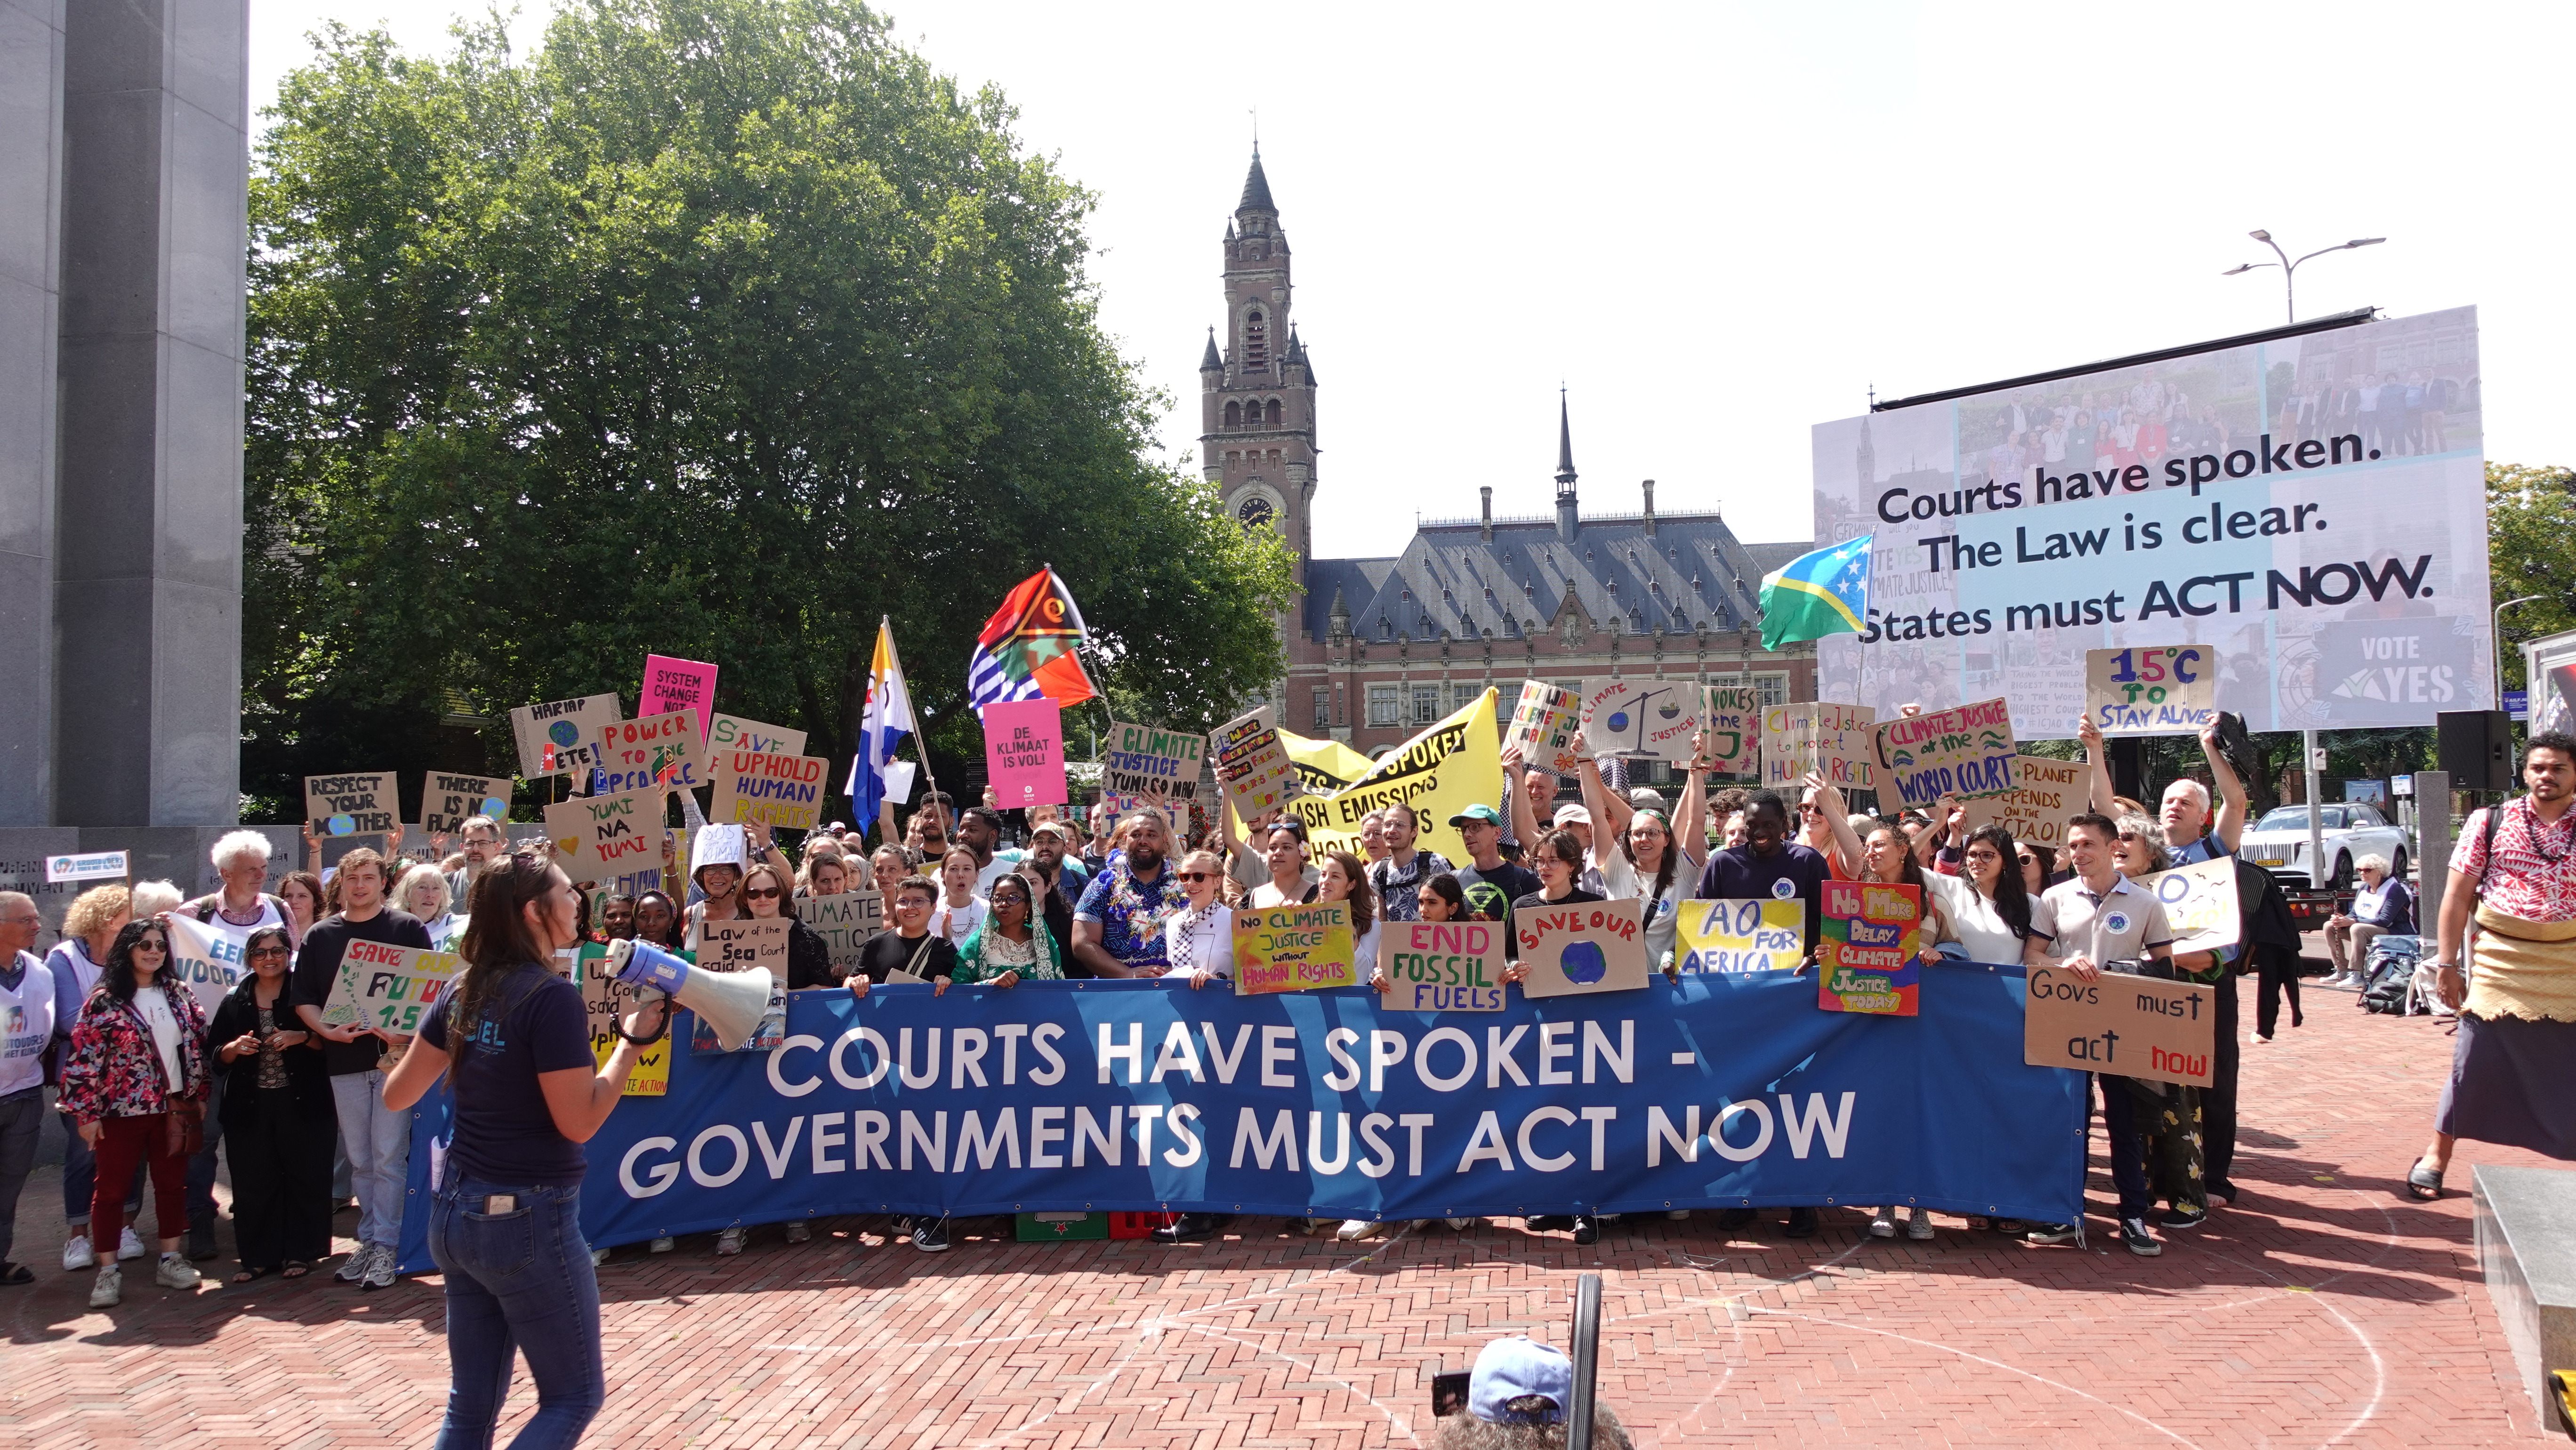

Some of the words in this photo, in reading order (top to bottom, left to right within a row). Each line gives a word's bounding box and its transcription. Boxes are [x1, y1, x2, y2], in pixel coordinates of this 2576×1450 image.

[1877, 479, 2022, 524] Courts
[2036, 468, 2149, 505] have
[2165, 433, 2382, 496] spoken.
[1919, 535, 2002, 573] The
[2017, 526, 2110, 564] Law
[2125, 513, 2162, 551] is
[2182, 501, 2327, 545] clear.
[1858, 606, 1992, 644] States
[2006, 588, 2124, 631] must
[2138, 572, 2254, 620] ACT
[2267, 555, 2433, 611] NOW.
[2361, 636, 2419, 660] VOTE
[657, 670, 701, 688] SYSTEM
[2011, 670, 2037, 678] TAKING
[2382, 666, 2454, 703] YES
[654, 685, 699, 703] CHANGE
[1582, 683, 1627, 724] CLIMATE
[2121, 683, 2166, 704] TO
[663, 701, 687, 713] NOT
[2010, 703, 2049, 715] HIGHEST
[2098, 704, 2152, 729] STAY
[1650, 715, 1696, 742] JUSTICE!
[1710, 713, 1740, 729] the
[1768, 708, 1831, 733] Climate
[1890, 712, 1955, 745] CLIMATE
[604, 716, 687, 749] POWER
[1014, 727, 1030, 739] DE
[1229, 721, 1259, 742] WHERE
[997, 739, 1049, 755] KLIMAAT
[1124, 728, 1199, 760] CLIMATE
[1777, 739, 1791, 752] to
[1798, 733, 1844, 756] protect
[1921, 738, 1937, 754] at
[1940, 733, 1972, 752] the
[621, 749, 645, 764] TO
[1003, 756, 1014, 768] IS
[1018, 753, 1045, 767] VOL!
[1111, 752, 1179, 776] JUSTICE
[598, 770, 605, 785] P
[734, 753, 820, 782] UPHOLD
[1832, 757, 1874, 786] RIGHTS
[1895, 767, 1953, 803] WORLD
[1957, 753, 2017, 793] COURT
[2024, 763, 2078, 784] PLANET
[311, 776, 382, 796] RESPECT
[437, 776, 489, 795] THERE
[737, 776, 816, 803] HUMAN
[1111, 771, 1146, 793] YUMI
[1171, 781, 1196, 799] NAU
[1234, 774, 1266, 796] COURTS
[1267, 764, 1290, 780] MUST
[325, 793, 379, 813] YOUR
[444, 796, 463, 815] IS
[586, 798, 634, 821] YUMI
[1253, 789, 1280, 810] NOT
[2004, 807, 2020, 817] ON
[2023, 808, 2039, 818] THE
[597, 819, 631, 840] NA
[706, 826, 734, 840] SOS
[596, 836, 647, 862] YUMI
[1241, 917, 1261, 928] NO
[1269, 909, 1344, 928] CLIMATE
[704, 922, 746, 941] Law
[751, 926, 762, 935] of
[765, 925, 781, 934] the
[1411, 925, 1489, 955] END
[1520, 911, 1585, 950] SAVE
[1590, 910, 1636, 941] OUR
[723, 943, 755, 961] Sea
[761, 942, 786, 956] Court
[1259, 932, 1323, 951] JUSTICE
[1755, 931, 1796, 951] FOR
[348, 942, 406, 967] SAVE
[415, 953, 457, 974] OUR
[702, 959, 734, 972] said
[1272, 951, 1309, 963] WITHOUT
[1680, 951, 1770, 974] AFRICA
[177, 958, 237, 987] VOOR
[1242, 966, 1289, 986] HUMAN
[1415, 984, 1501, 1010] FUELS
[1847, 995, 1897, 1009] TODAY
[2030, 969, 2098, 1005] Govs
[2137, 992, 2203, 1020] must
[378, 1005, 422, 1030] 1.5
[756, 1037, 783, 1047] ACTION
[766, 1023, 1066, 1098] COURTS
[1097, 1022, 1296, 1088] HAVE
[1322, 1019, 1634, 1092] SPOKEN
[2069, 1030, 2119, 1063] act
[2151, 1046, 2206, 1077] now
[639, 1079, 667, 1093] ACTION
[619, 1103, 1202, 1200] GOVERNMENTS
[1229, 1106, 1433, 1178] MUST
[1457, 1105, 1617, 1172] ACT
[1647, 1090, 1857, 1168] NOW
